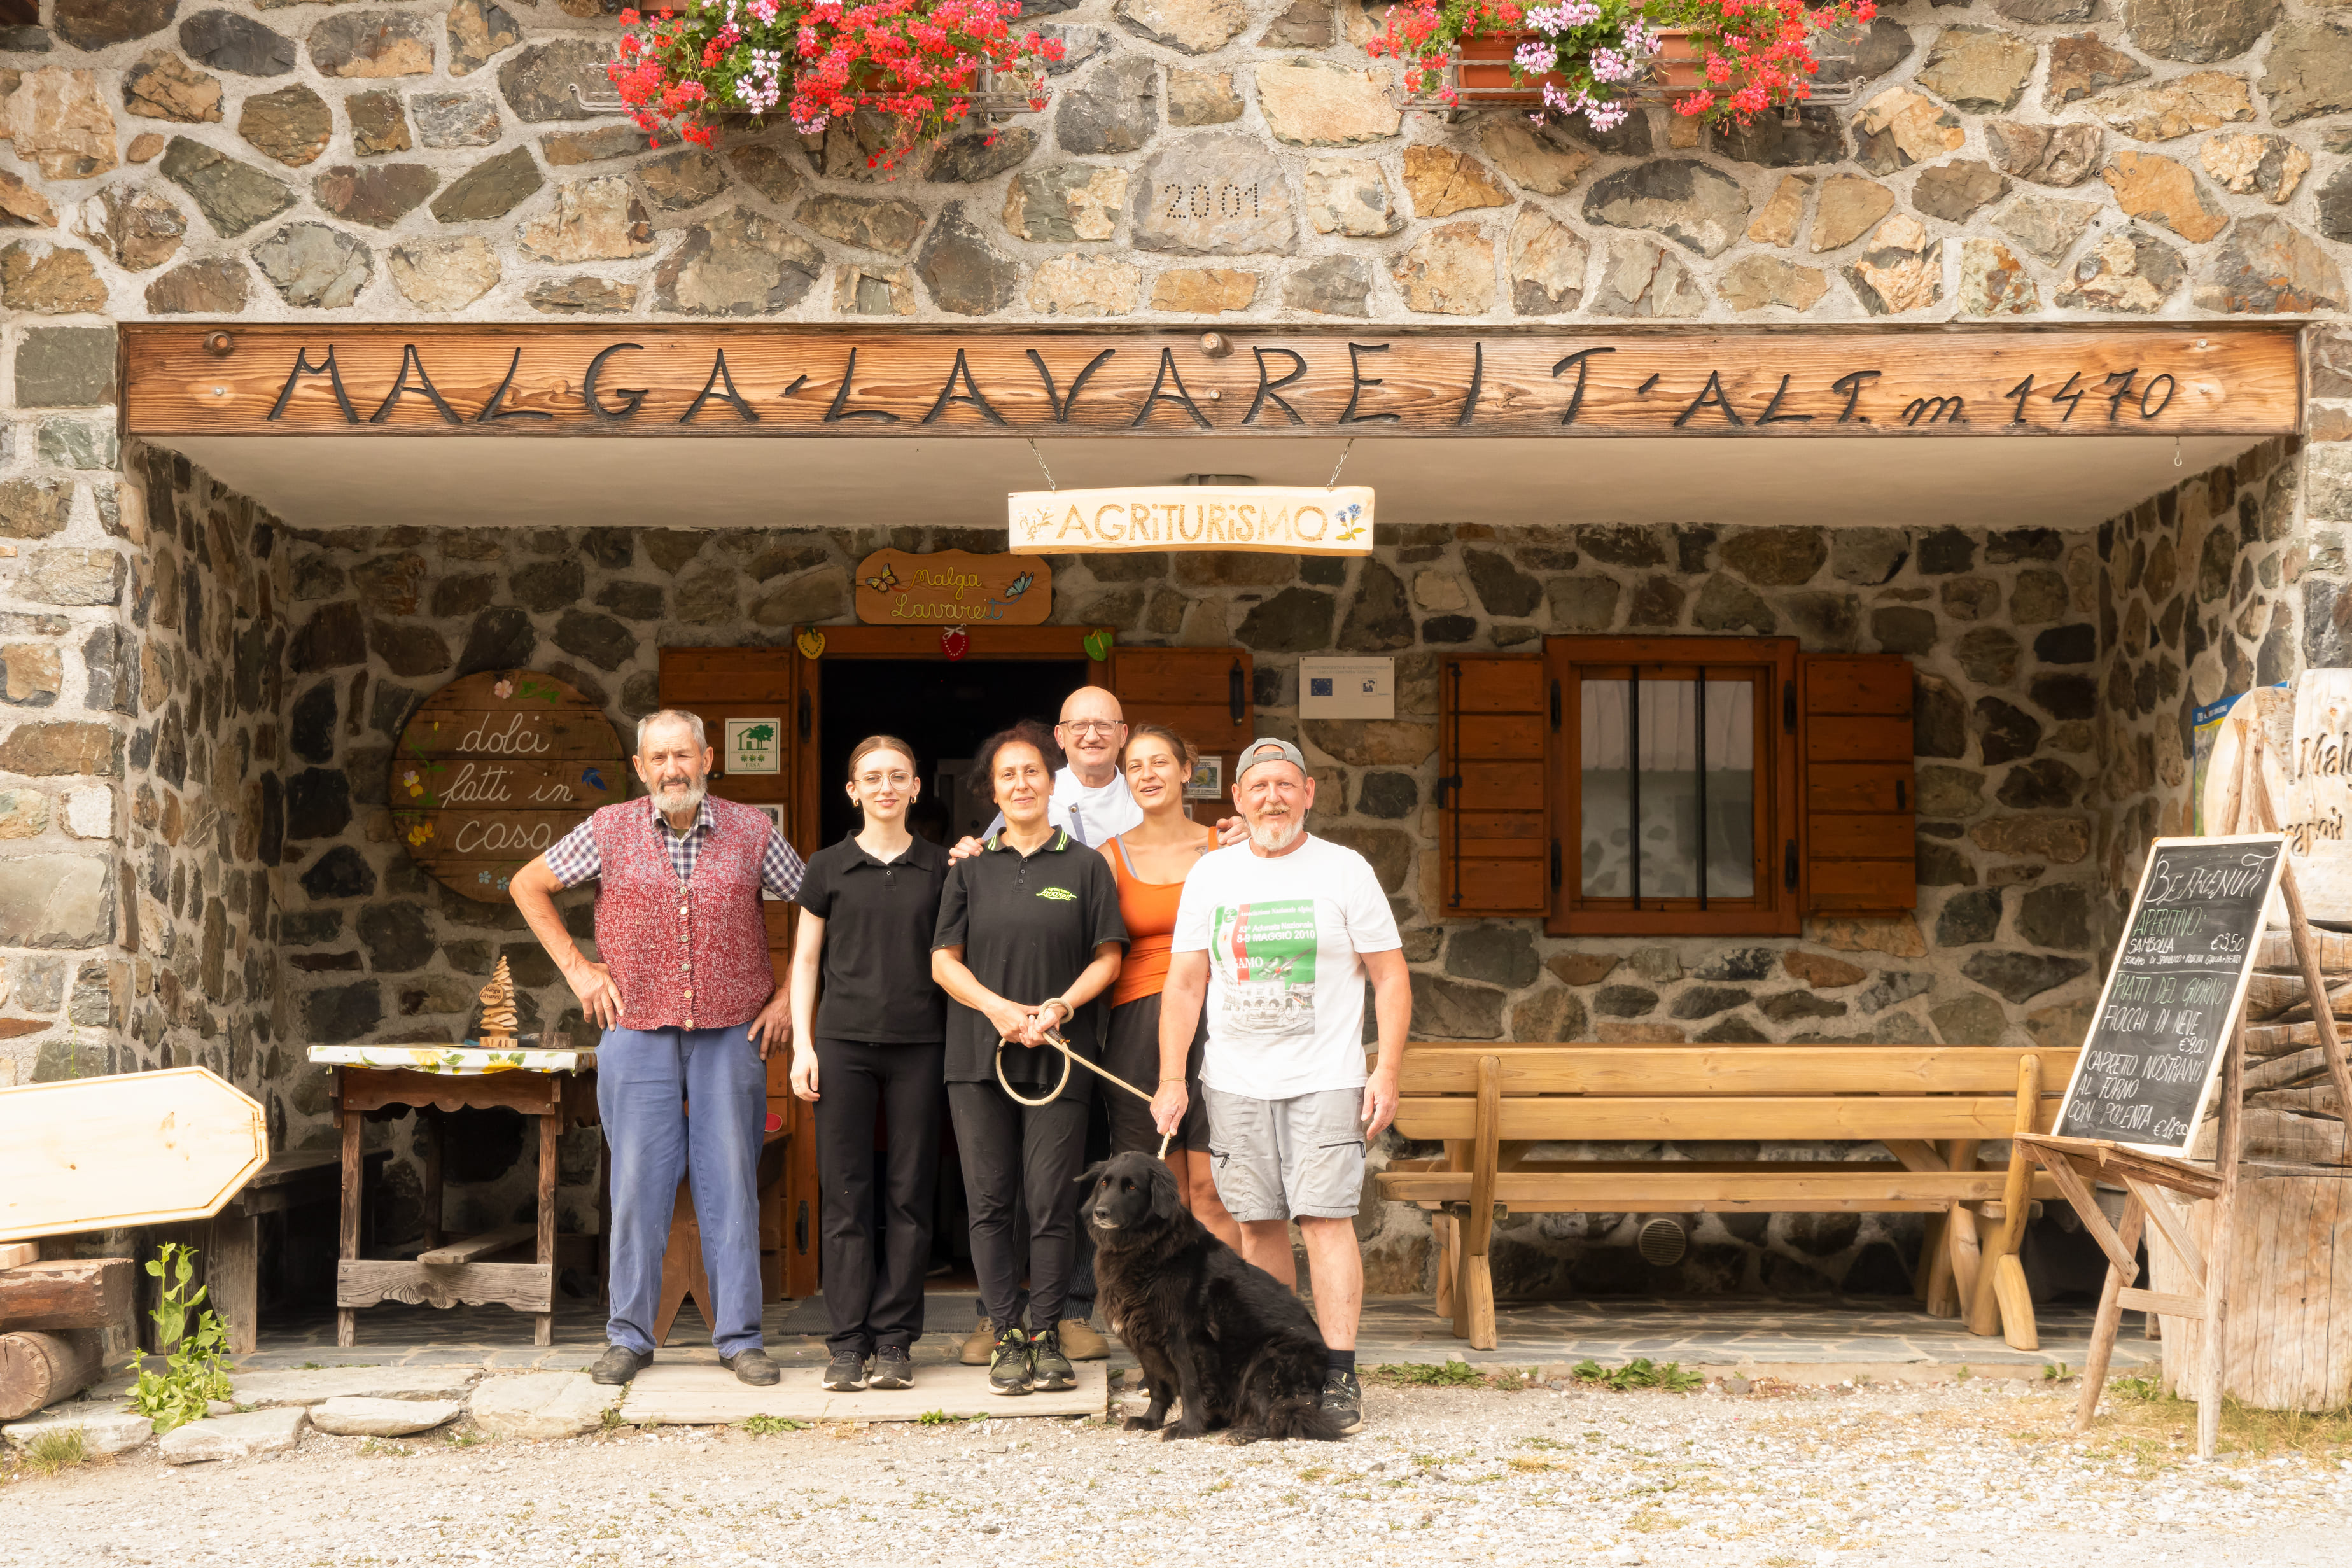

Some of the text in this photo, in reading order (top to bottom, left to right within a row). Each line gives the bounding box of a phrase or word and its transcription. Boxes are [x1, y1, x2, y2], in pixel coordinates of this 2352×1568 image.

[1165, 183, 1258, 219] 2001
[266, 342, 759, 424] MALGA
[823, 341, 1616, 430] LAVAREIT
[2005, 367, 2176, 425] 1470
[908, 566, 983, 600] Malga
[890, 593, 1004, 620] Lavareit
[456, 712, 549, 753] dolci
[2297, 731, 2352, 790] Mal
[439, 763, 573, 808] fatti in
[1236, 930, 1315, 943] 8-9 MAGGIO 2010
[1252, 923, 1280, 932] Adunata
[2210, 933, 2244, 952] €3,50
[479, 991, 501, 1000] Lavareit
[2112, 973, 2227, 1007] PIATTI DEL GIORNO
[2101, 1005, 2202, 1036] FIOCCHI DI NEVE
[2178, 1036, 2208, 1054] €9,00
[2087, 1050, 2205, 1083] CAPRETTO NOSTRANO
[2076, 1074, 2139, 1100] AL FORNO
[2068, 1099, 2153, 1130] CON POLENTA
